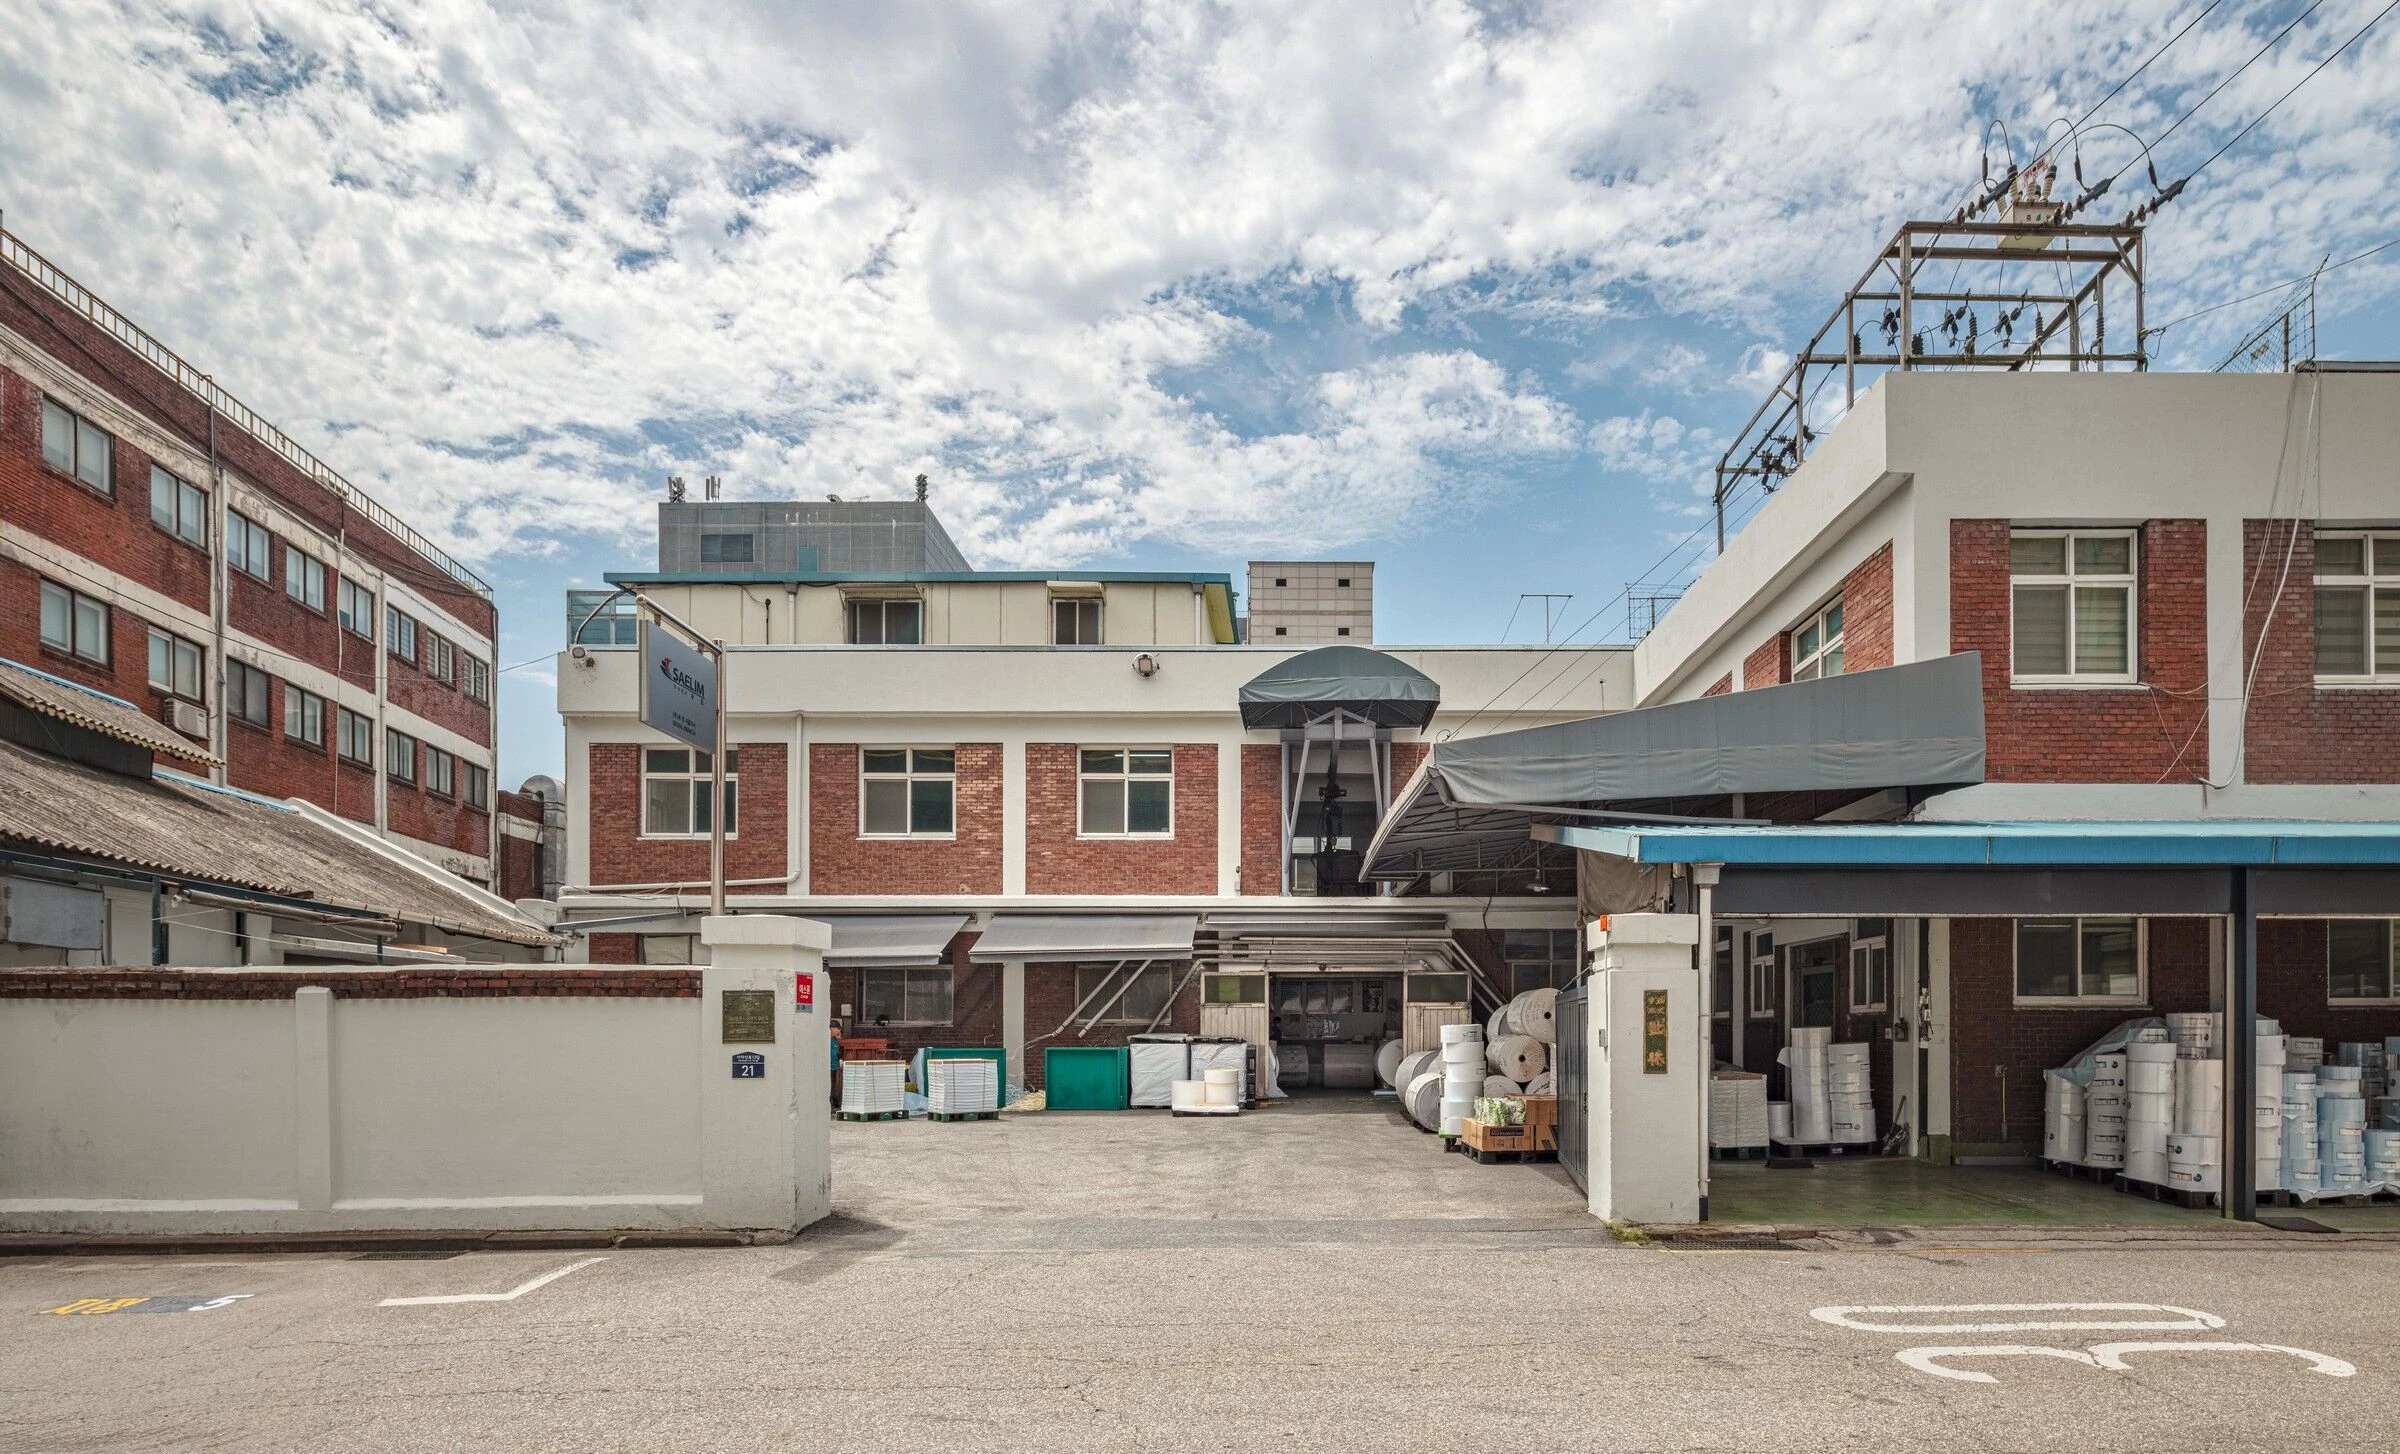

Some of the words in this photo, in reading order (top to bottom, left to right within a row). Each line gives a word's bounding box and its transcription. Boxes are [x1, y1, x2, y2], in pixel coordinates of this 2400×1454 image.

[673, 667, 704, 697] SAELIM
[741, 1065, 754, 1076] 21
[188, 1293, 255, 1312] 5
